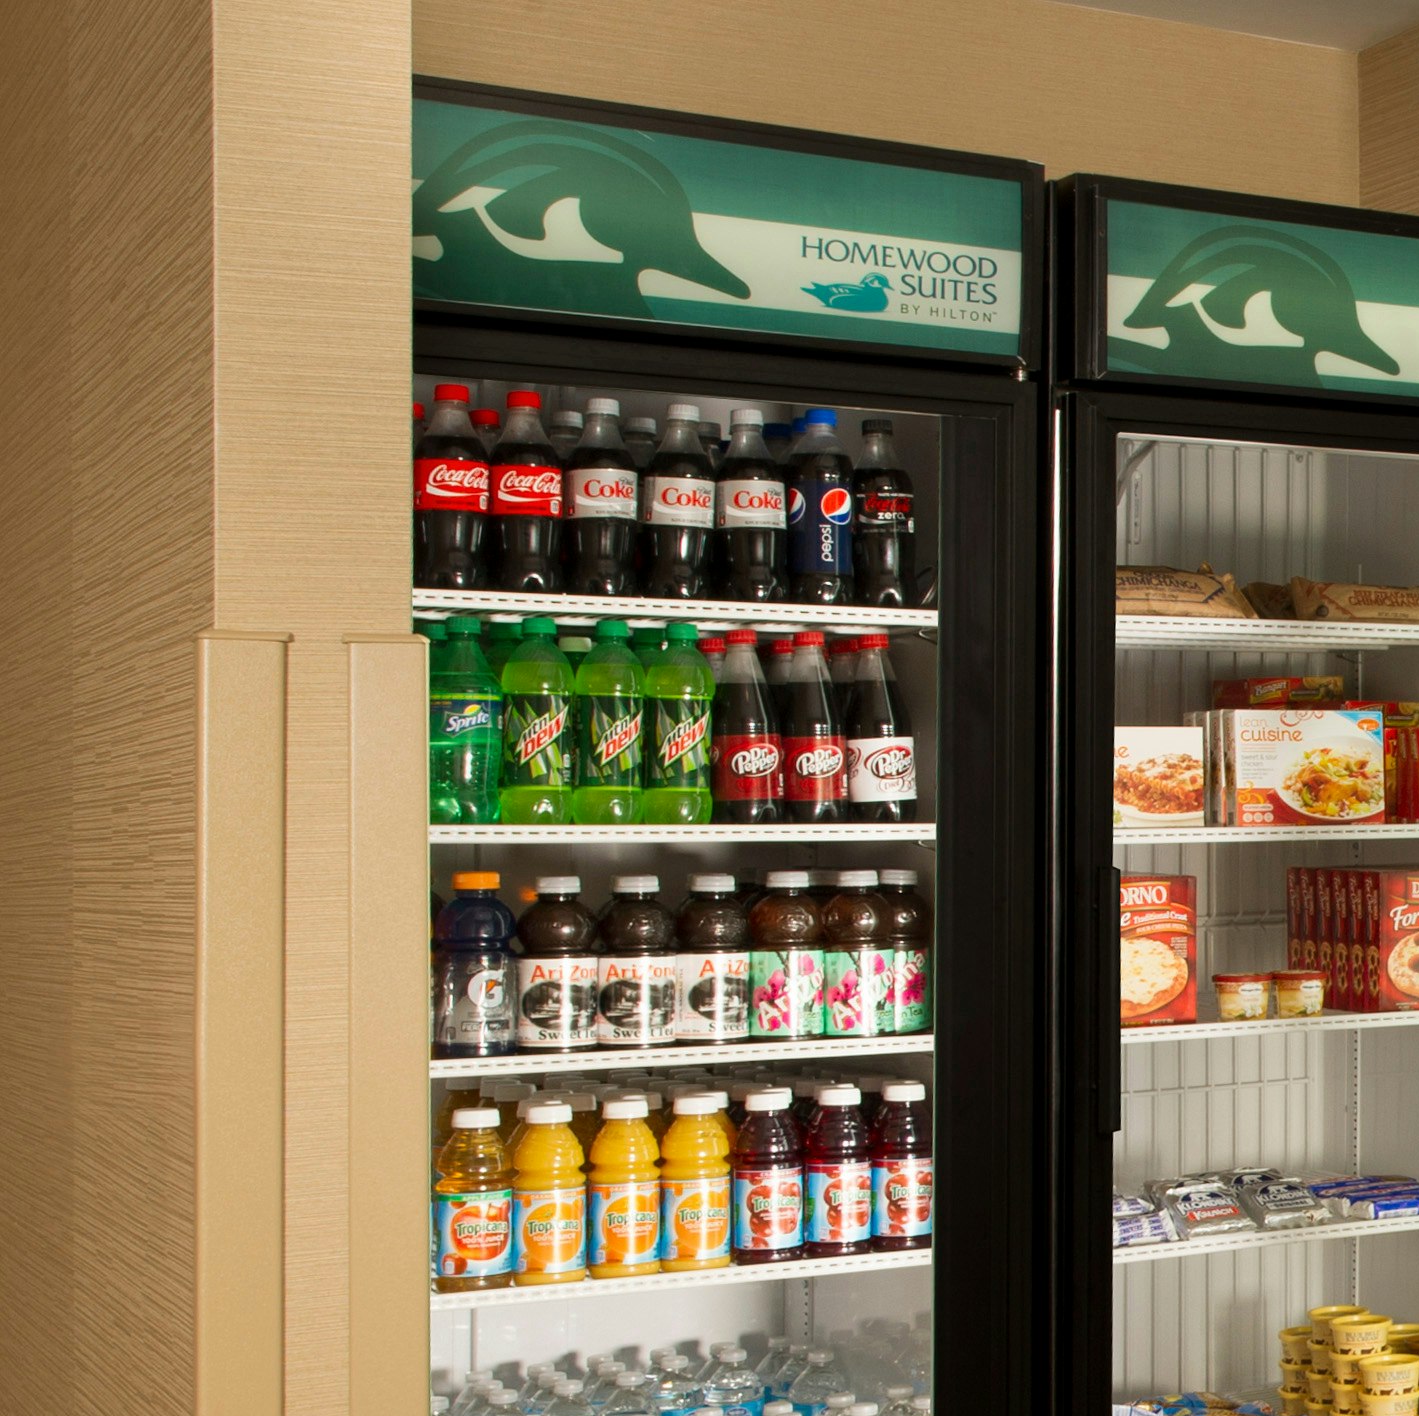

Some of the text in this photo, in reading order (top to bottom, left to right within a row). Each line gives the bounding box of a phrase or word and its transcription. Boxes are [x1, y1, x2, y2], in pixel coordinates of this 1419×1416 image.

[801, 235, 998, 280] HOMEWOOD
[900, 273, 998, 306] SUITES
[900, 303, 921, 316] BY
[584, 479, 634, 499] Coke
[661, 488, 712, 509] Coke
[733, 490, 783, 511] Coke
[877, 511, 906, 521] zero
[820, 524, 834, 563] pepsi
[446, 709, 490, 733] Sprite
[1240, 726, 1304, 743] cuisine
